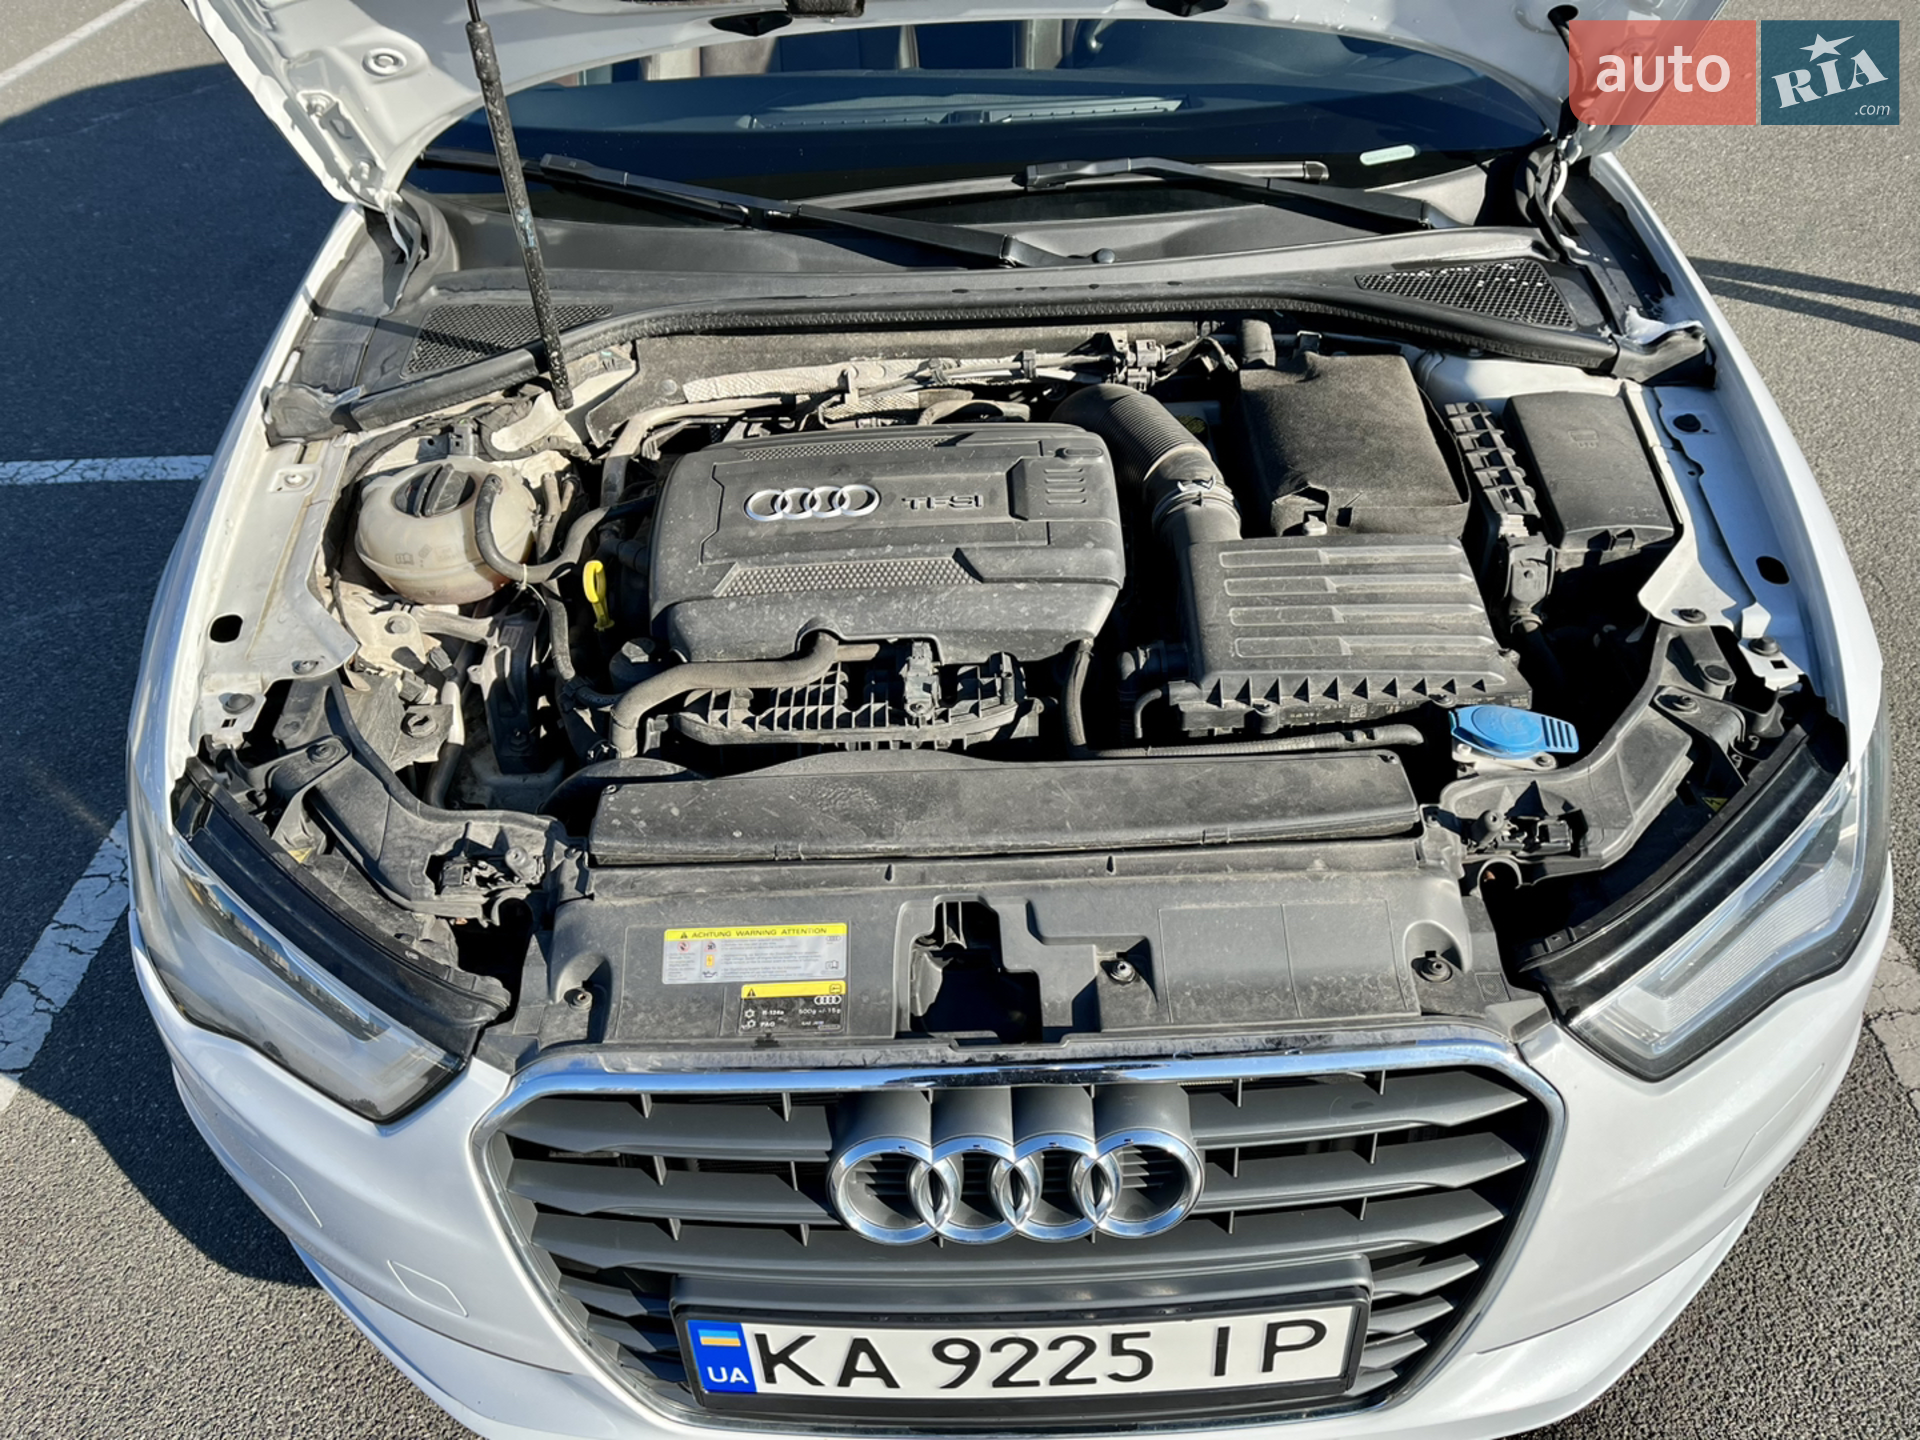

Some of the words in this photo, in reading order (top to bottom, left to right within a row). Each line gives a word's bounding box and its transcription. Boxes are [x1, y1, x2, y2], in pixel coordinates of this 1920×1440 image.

[901, 495, 984, 511] TFSI
[691, 930, 732, 938] ACHTUNG
[736, 929, 777, 937] WARNING
[781, 927, 828, 936] ATTENTION
[754, 1332, 901, 1389] KA
[931, 1331, 1154, 1389] 9225
[1213, 1319, 1328, 1377] IP
[707, 1366, 749, 1384] UA
